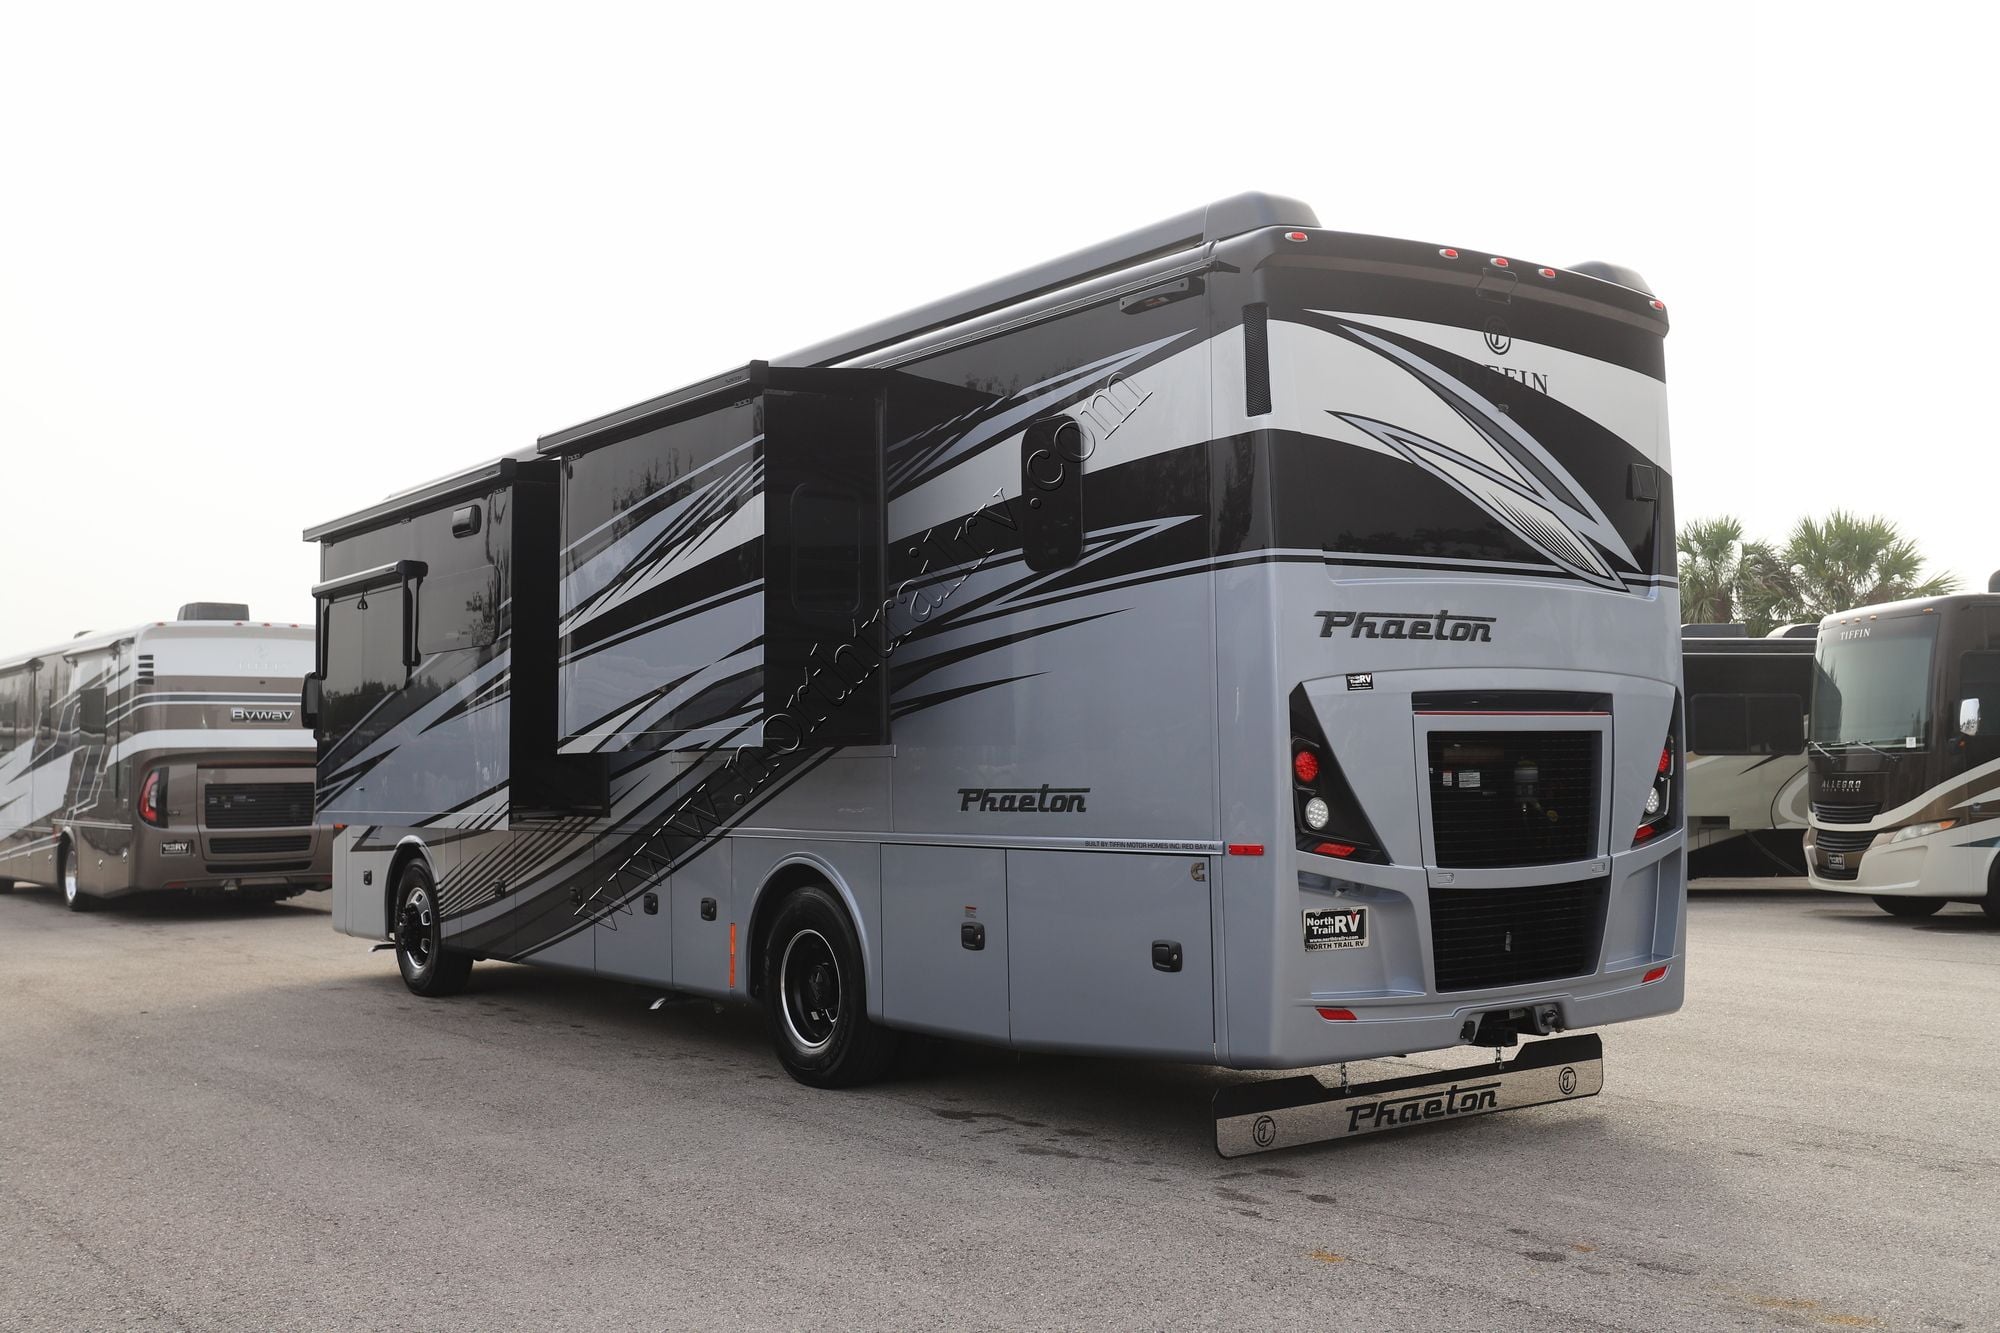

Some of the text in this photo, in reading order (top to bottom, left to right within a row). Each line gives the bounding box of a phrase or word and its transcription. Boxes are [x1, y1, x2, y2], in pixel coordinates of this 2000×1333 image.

[1314, 610, 1497, 643] Phaeton
[1840, 628, 1871, 641] TIFFIN
[1821, 779, 1861, 789] ALLEGRO
[957, 784, 1091, 812] Phaeton
[1307, 917, 1334, 926] North
[1335, 914, 1360, 934] RV
[1312, 925, 1334, 935] Trail
[1346, 1082, 1502, 1132] Phaeton
